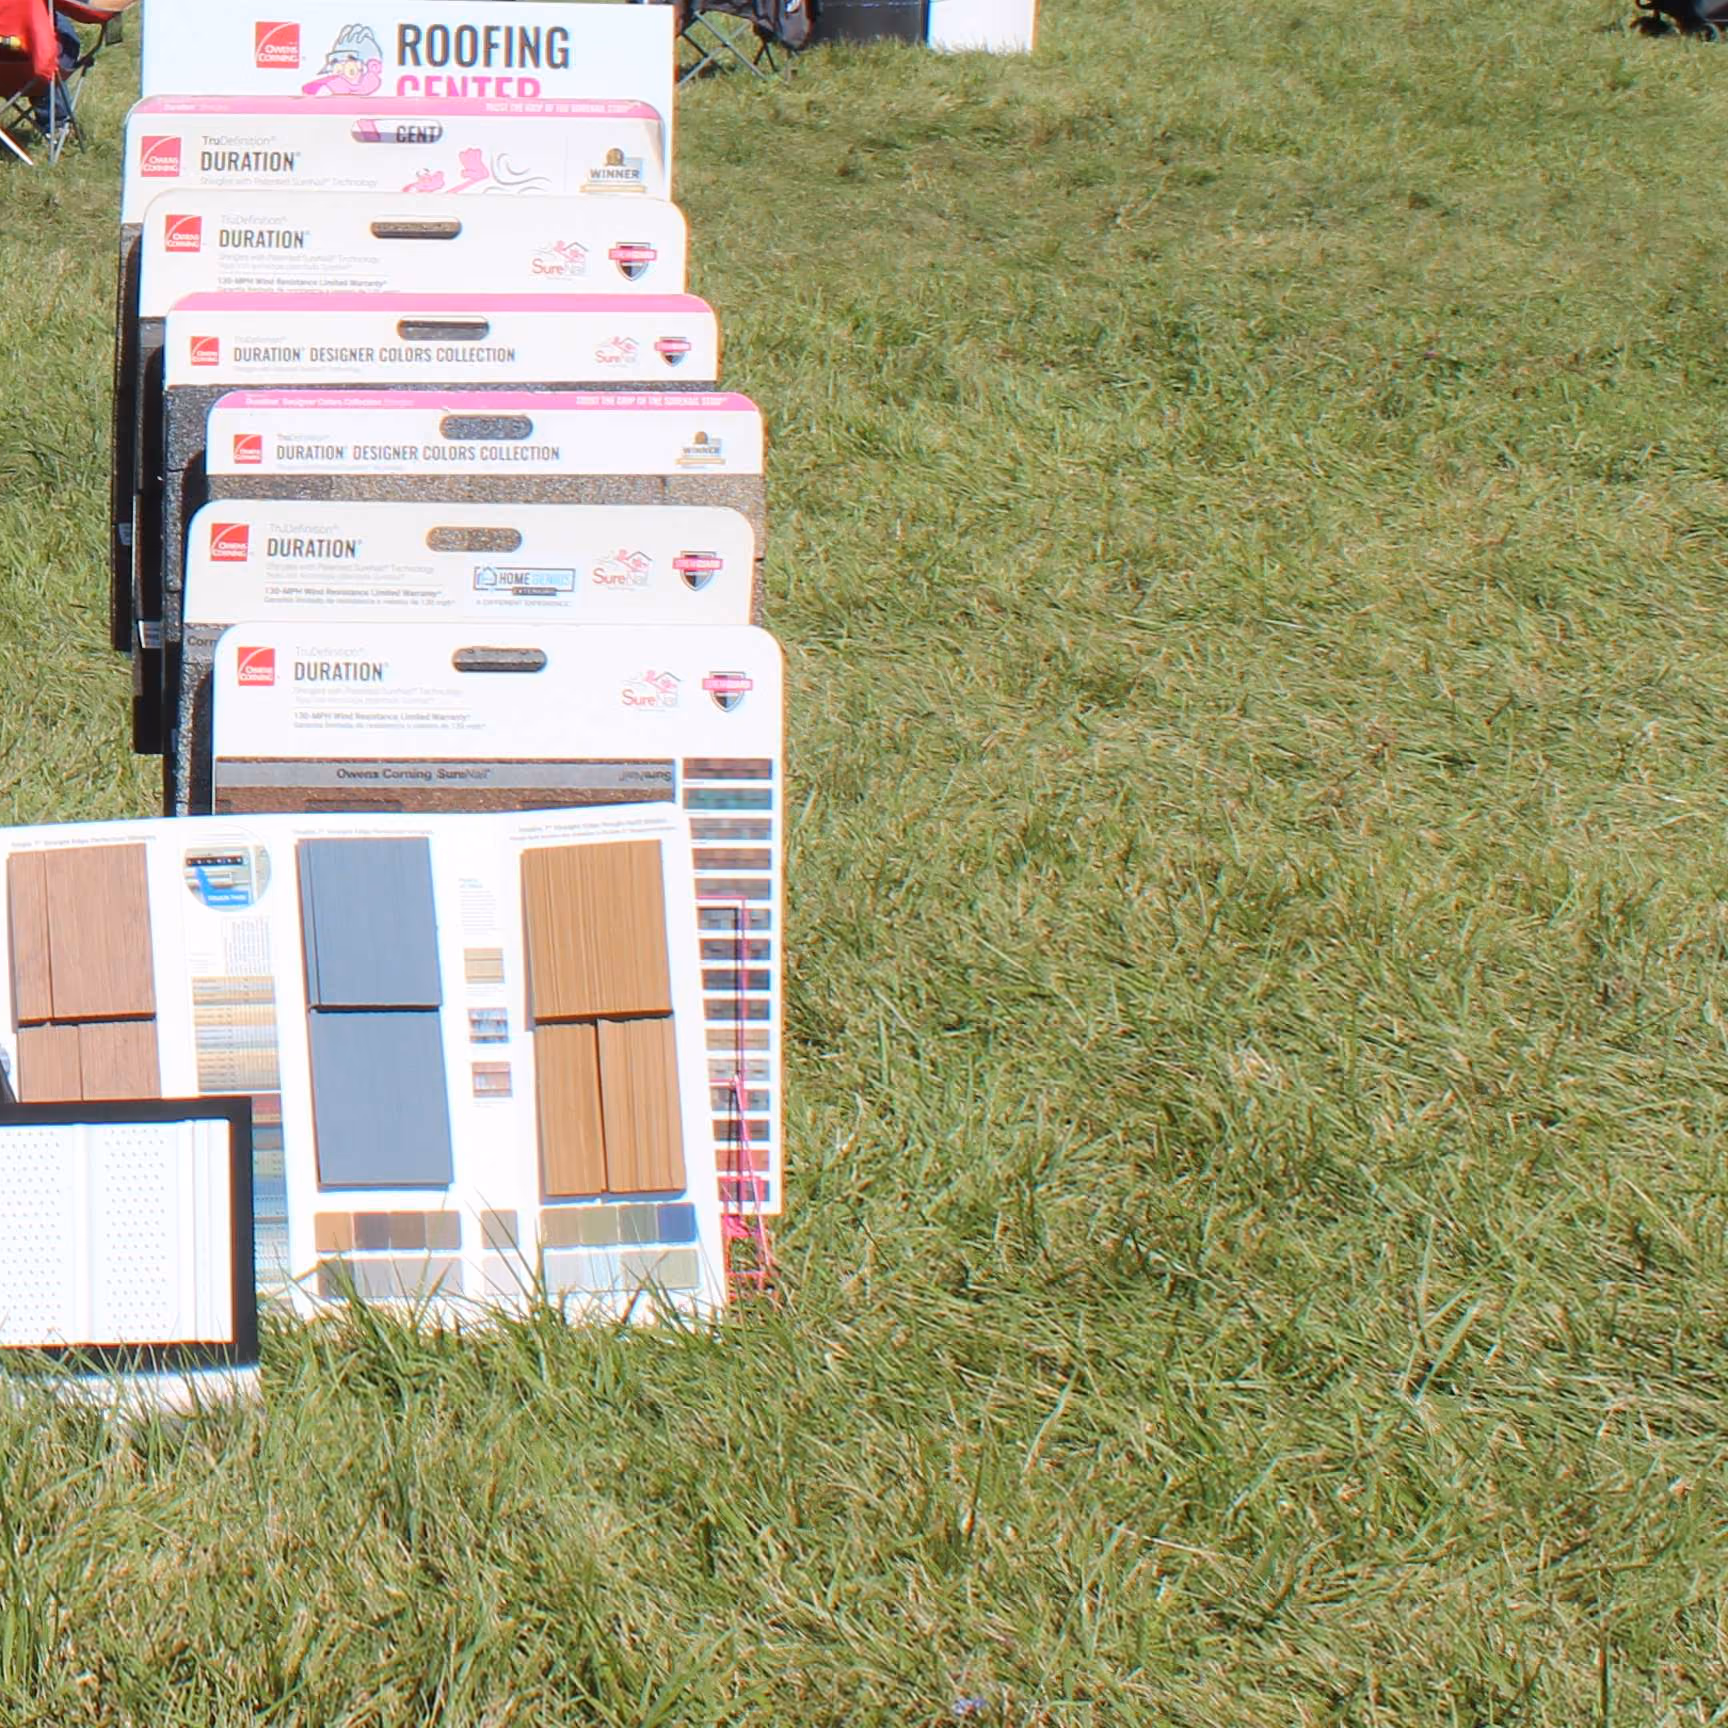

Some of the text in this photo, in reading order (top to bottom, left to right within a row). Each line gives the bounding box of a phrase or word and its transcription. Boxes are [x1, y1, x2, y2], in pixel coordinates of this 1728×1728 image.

[397, 22, 570, 70] ROOFING
[200, 151, 296, 173] DURATION
[589, 168, 640, 180] WINNER
[218, 229, 305, 249] DURATION
[234, 347, 516, 364] DURATION DESIGNER COLORS COLLECTION
[276, 445, 561, 462] DURATION DESIGNER COLORS COLLECTION
[267, 537, 357, 559] DURATION
[498, 572, 530, 585] HOME
[293, 661, 384, 682] DURATION
[336, 767, 379, 780] Owens
[380, 767, 433, 783] Corning
